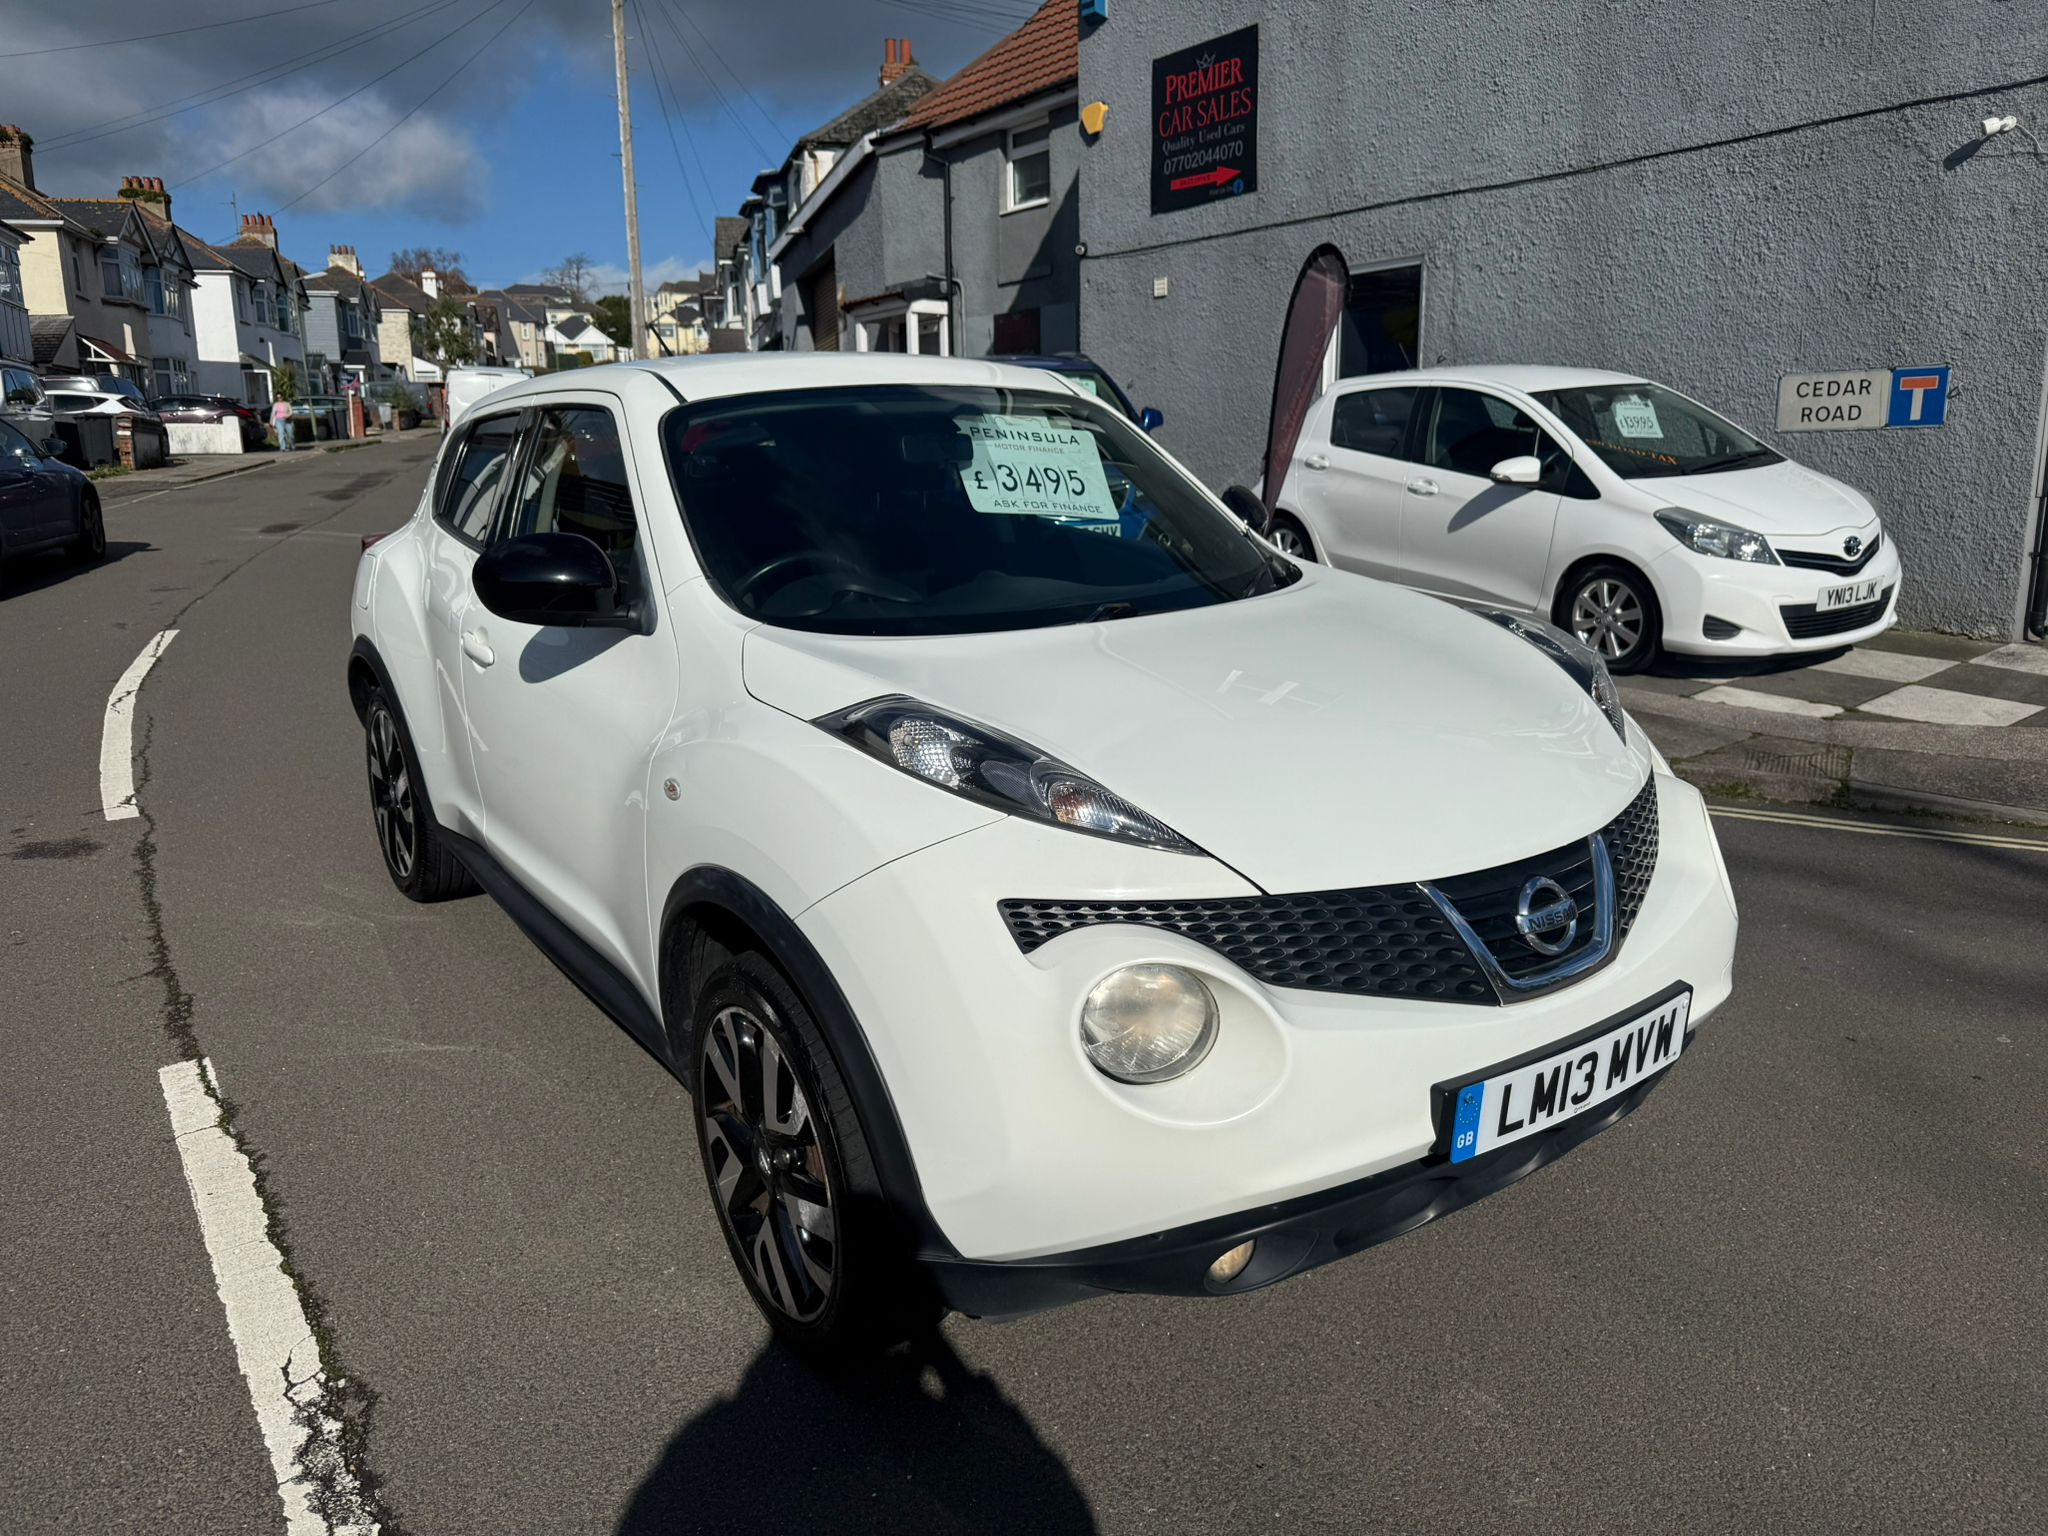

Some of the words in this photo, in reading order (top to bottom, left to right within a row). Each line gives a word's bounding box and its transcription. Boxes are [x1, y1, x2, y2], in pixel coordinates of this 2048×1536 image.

[1165, 57, 1244, 105] PREMIER
[1159, 105, 1193, 138] CAR
[1196, 87, 1252, 127] SALES
[1162, 136, 1196, 156] Quality
[1199, 125, 1221, 143] Used
[1223, 122, 1246, 136] Cars
[1163, 140, 1243, 175] 07702044070
[1796, 378, 1872, 398] CEDAR
[1801, 405, 1862, 422] ROAD
[969, 426, 1080, 446] PENINSULA
[994, 442, 1026, 451] MOTOR
[1028, 445, 1065, 454] FINANCE
[994, 499, 1020, 509] ASK
[1023, 501, 1048, 510] FOR
[1052, 502, 1104, 514] FINANCE
[1827, 586, 1854, 607] YN13
[1855, 582, 1877, 601] LJK
[1497, 1050, 1599, 1137] LM13
[1605, 1008, 1678, 1090] MVW
[1456, 1130, 1474, 1149] GB
